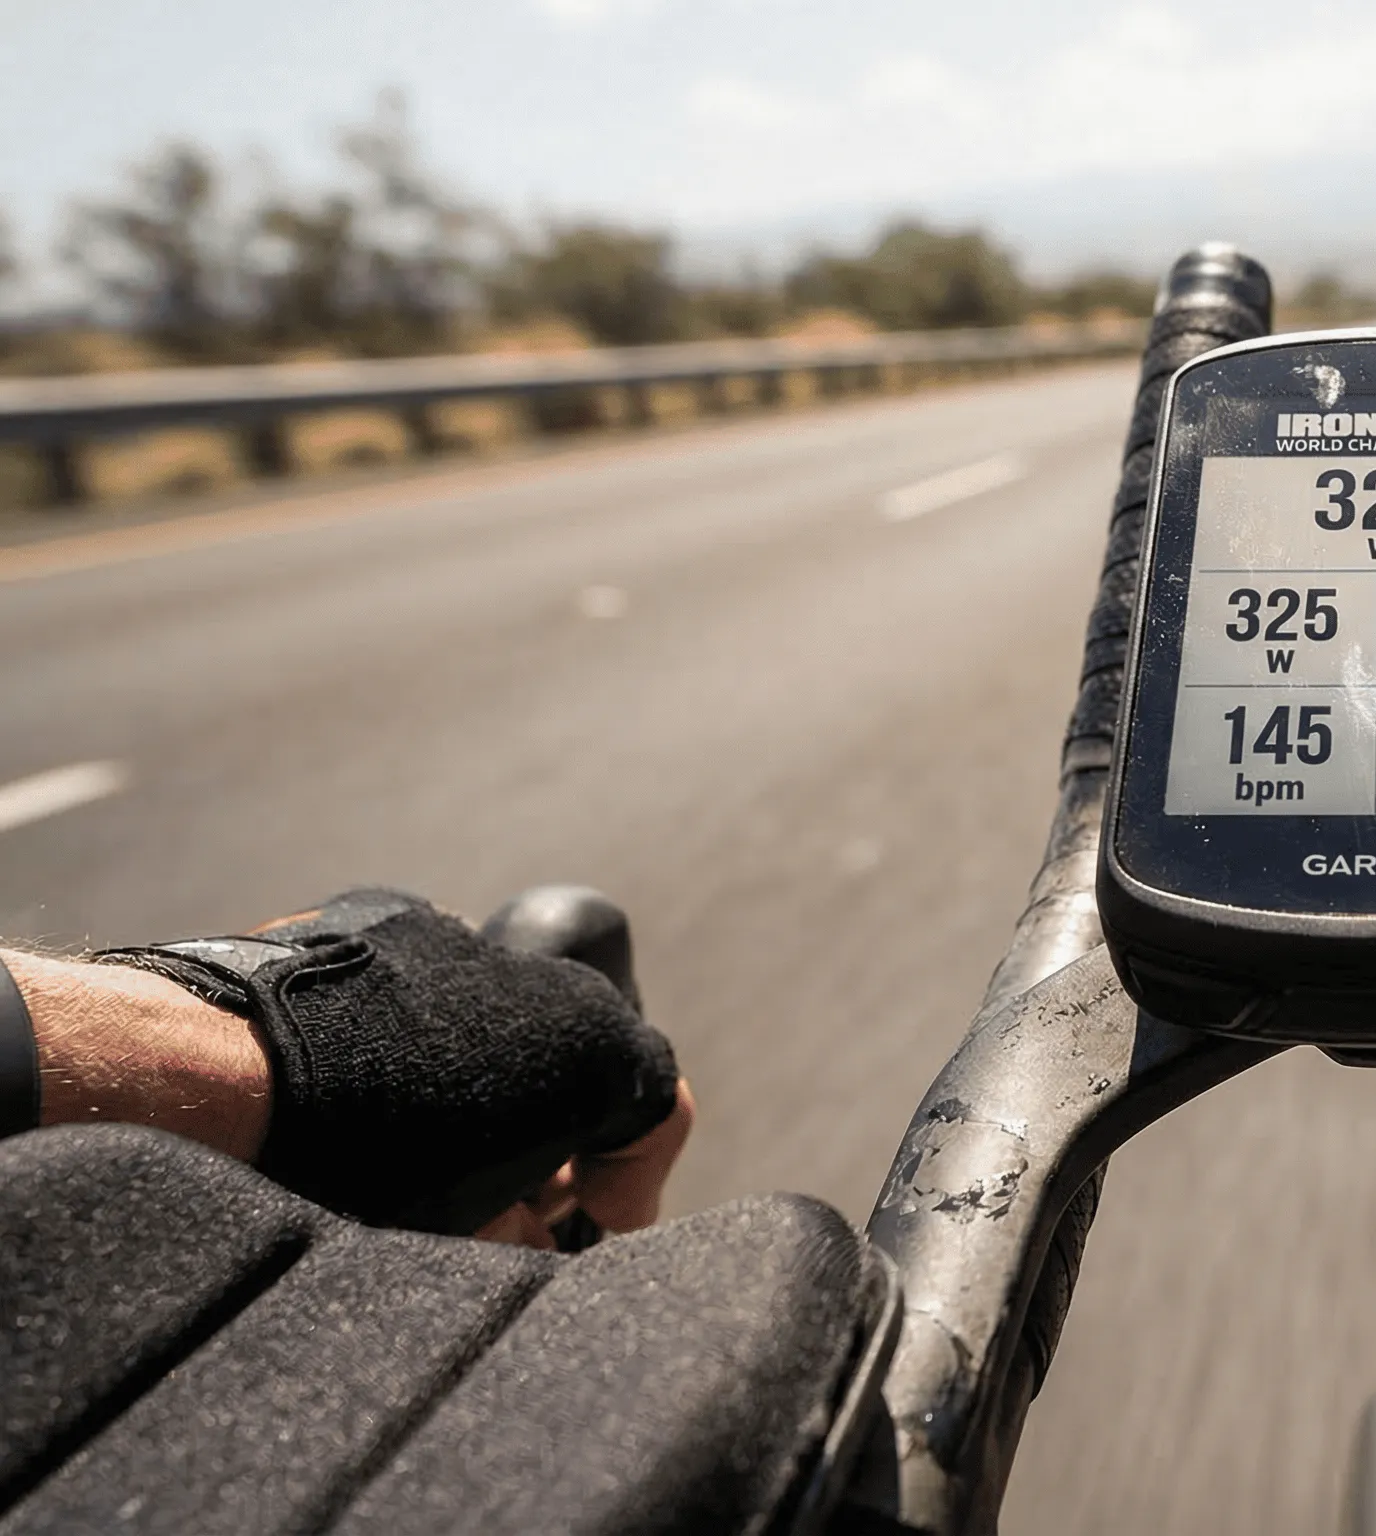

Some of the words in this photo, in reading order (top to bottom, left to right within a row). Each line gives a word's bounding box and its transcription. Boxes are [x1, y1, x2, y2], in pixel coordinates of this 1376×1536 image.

[1276, 438, 1343, 452] WORLD
[1225, 588, 1338, 642] 325
[1266, 650, 1295, 673] W
[1224, 705, 1332, 765] 145
[1235, 773, 1304, 806] bpm
